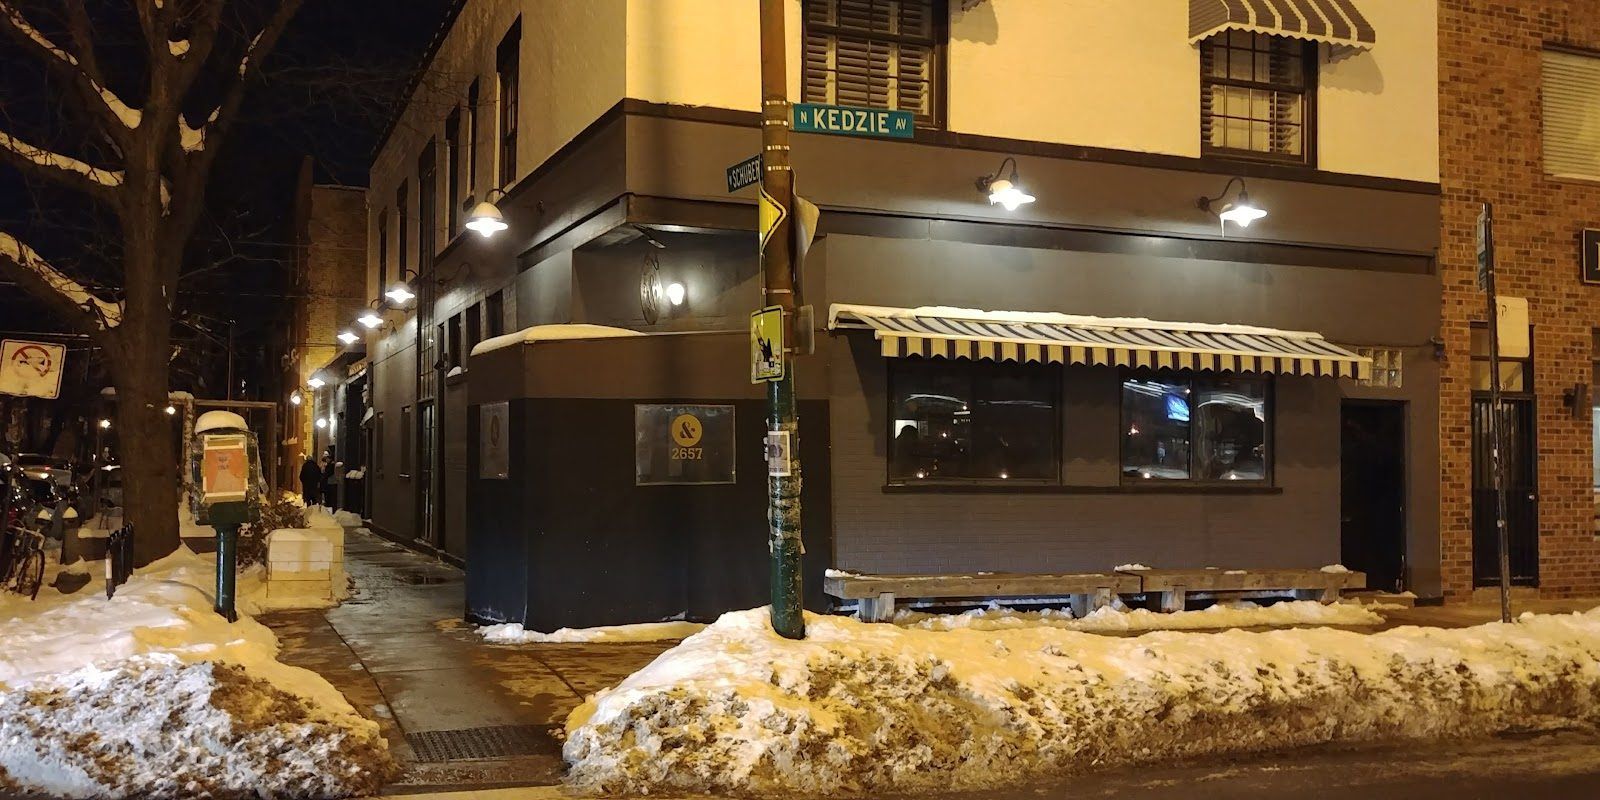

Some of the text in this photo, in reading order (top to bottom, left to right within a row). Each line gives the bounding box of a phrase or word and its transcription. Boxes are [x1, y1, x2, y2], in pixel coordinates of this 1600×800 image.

[800, 108, 907, 133] N KEDZIE AV
[732, 160, 760, 188] SCHUBER
[680, 421, 696, 439] &
[671, 447, 703, 460] 2657
